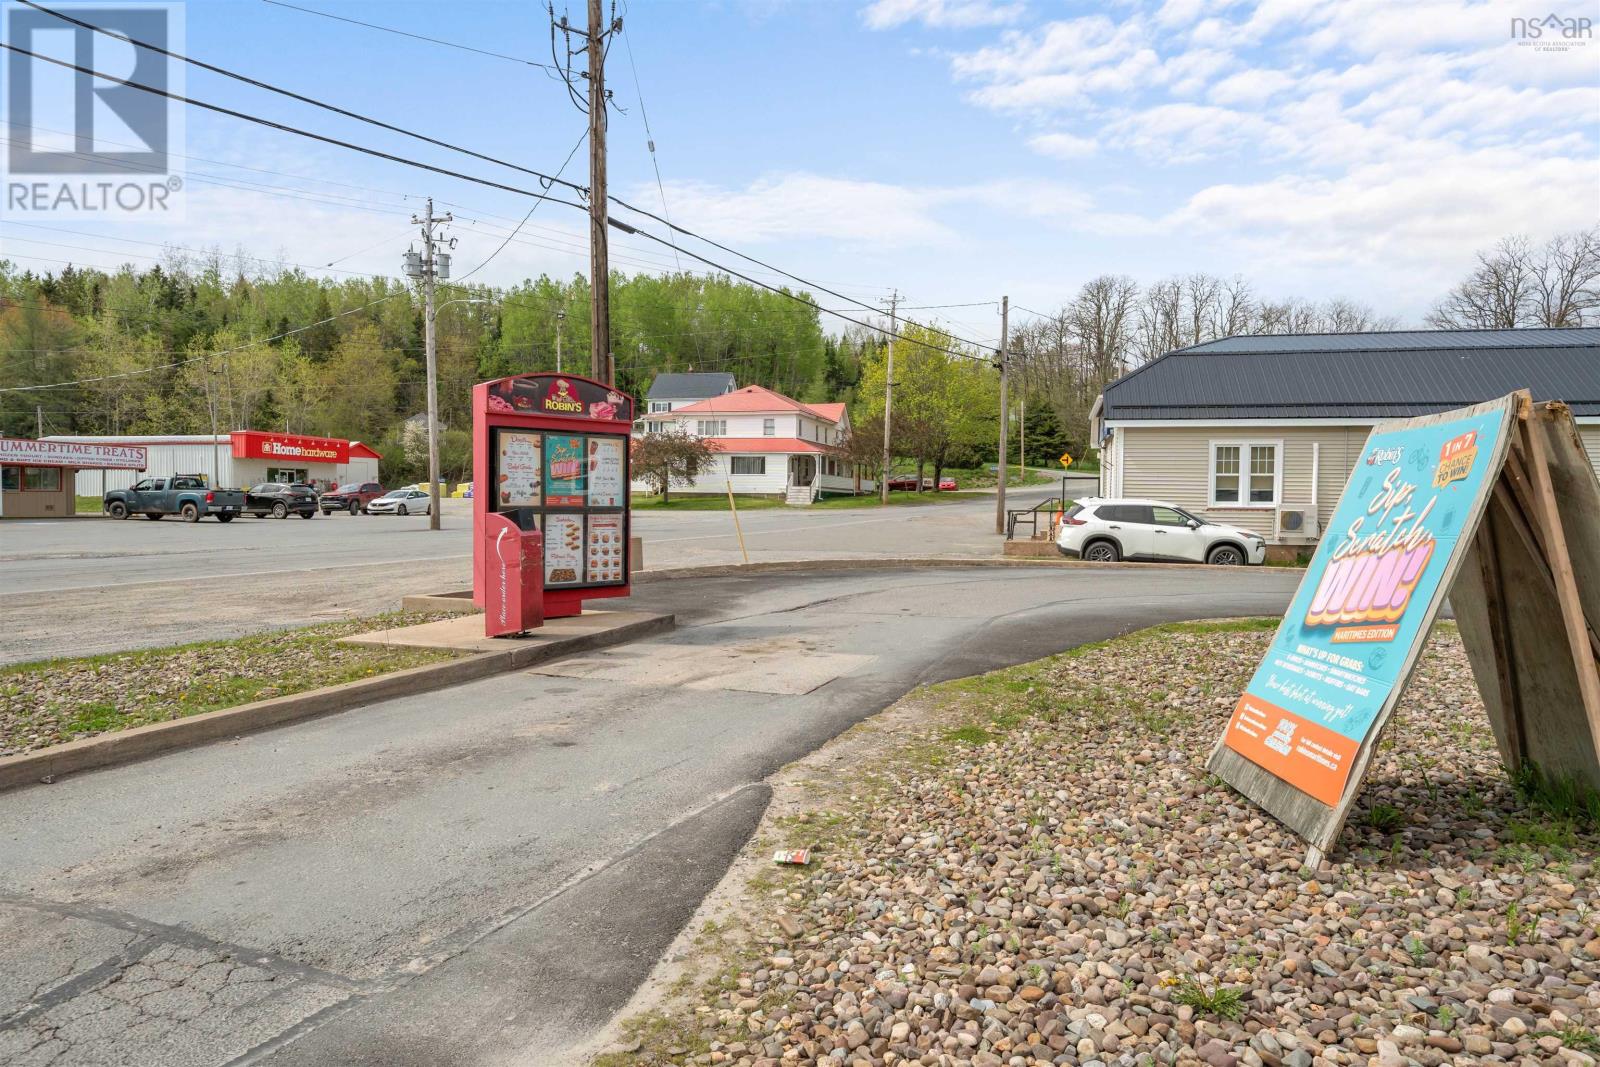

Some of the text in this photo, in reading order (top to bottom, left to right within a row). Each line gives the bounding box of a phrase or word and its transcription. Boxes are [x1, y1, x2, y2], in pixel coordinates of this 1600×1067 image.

[545, 399, 582, 412] ROBIN'S
[0, 440, 144, 460] UMMERTIME TREATS
[272, 442, 337, 459] Home hardware
[1445, 433, 1473, 457] 1 IN 7
[1442, 454, 1472, 469] CHANCE
[1438, 471, 1449, 483] TO
[1310, 540, 1435, 615] WIN!
[1335, 628, 1395, 640] MARITIMES EDITION
[1327, 653, 1340, 665] FOR
